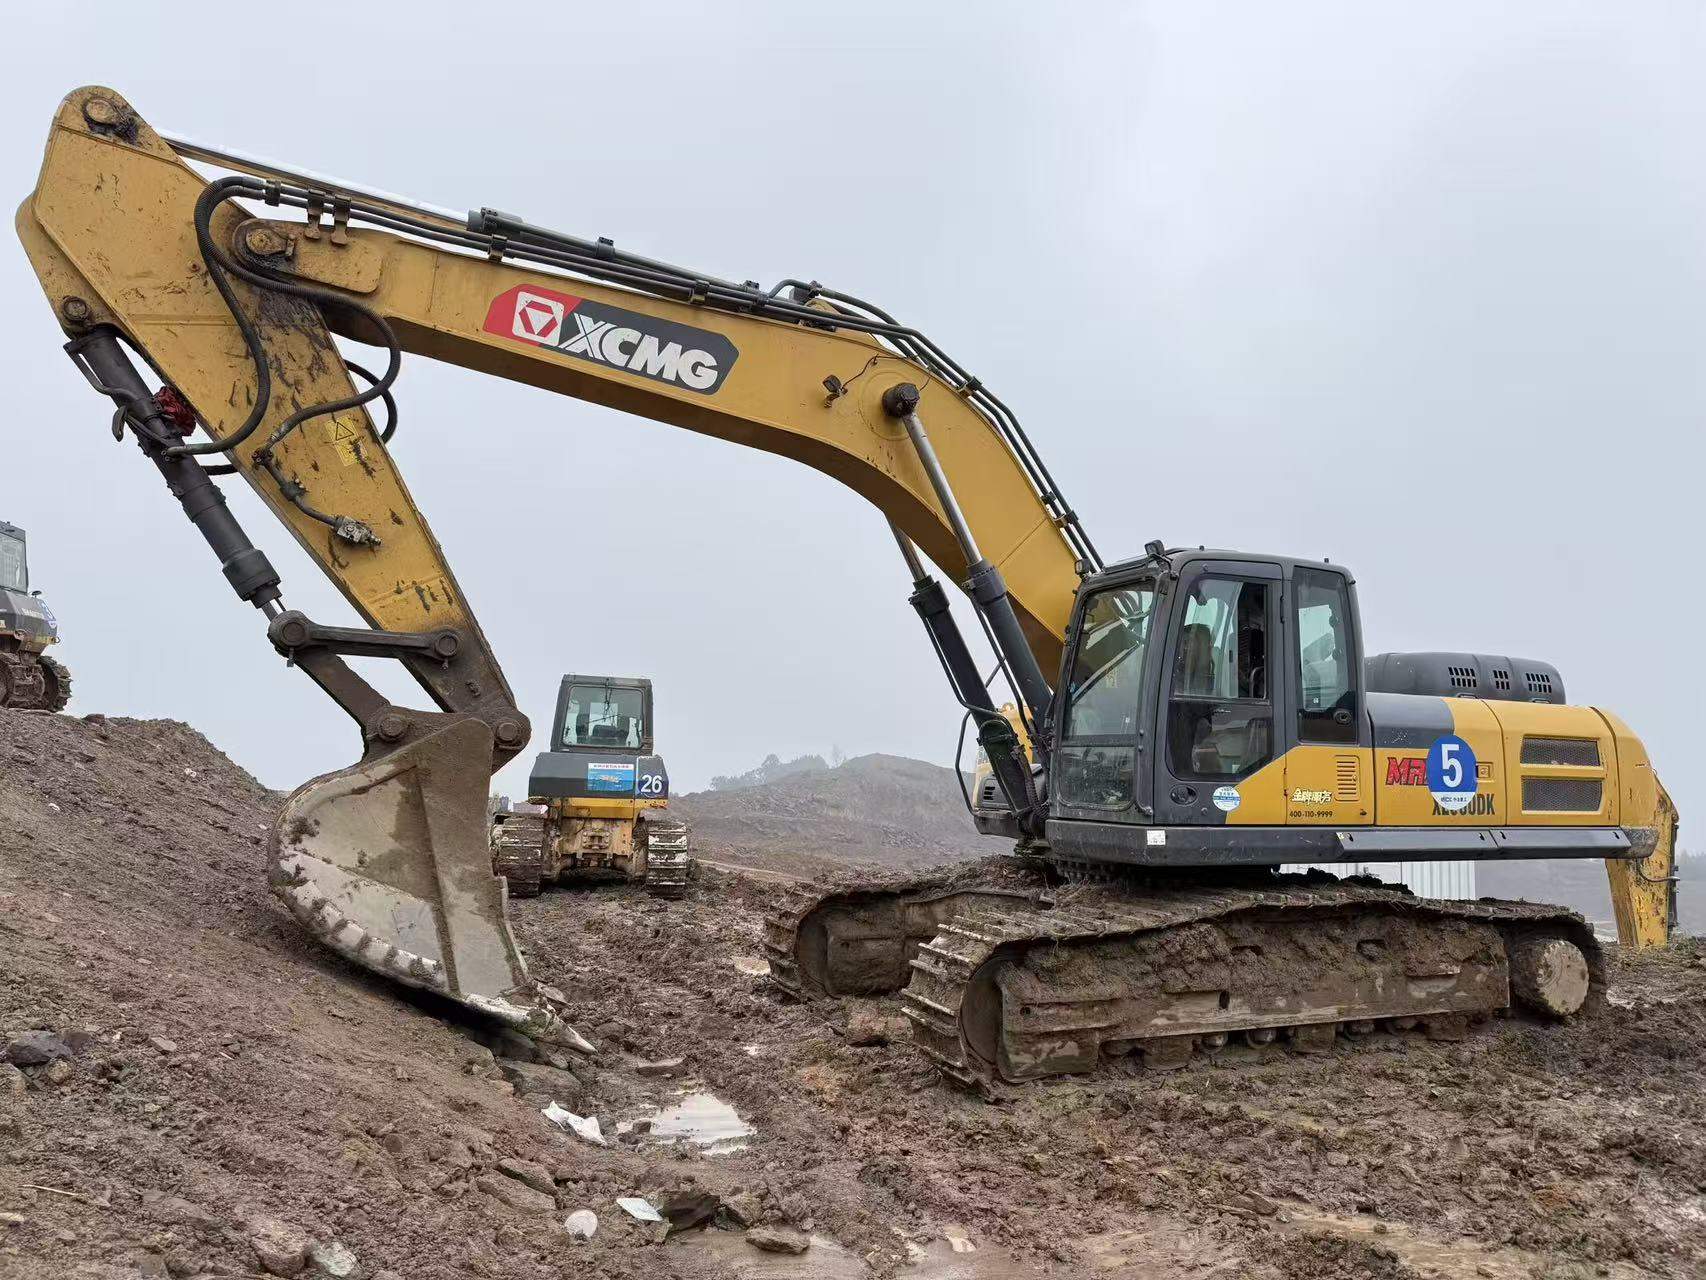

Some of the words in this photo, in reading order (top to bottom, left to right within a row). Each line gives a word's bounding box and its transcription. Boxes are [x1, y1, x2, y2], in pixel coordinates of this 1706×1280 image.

[558, 313, 718, 389] XCMG
[1441, 744, 1463, 788] 5
[640, 774, 662, 793] 26
[1289, 810, 1333, 818] 400-110-9999
